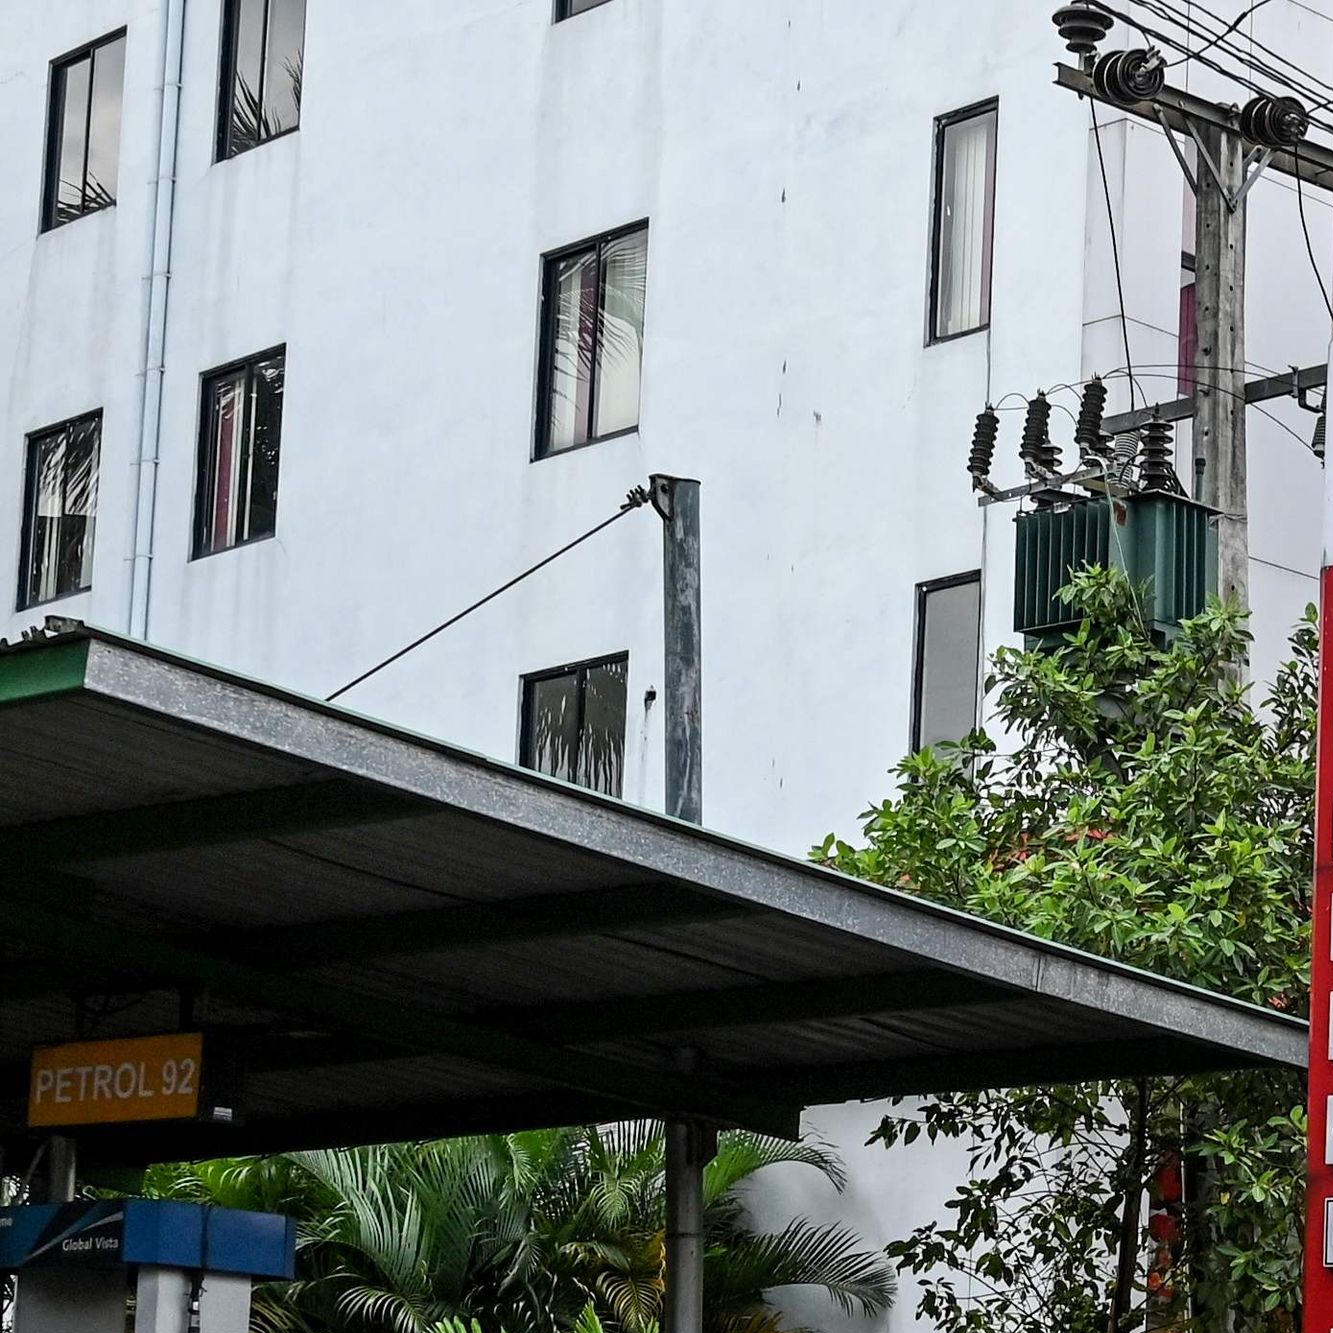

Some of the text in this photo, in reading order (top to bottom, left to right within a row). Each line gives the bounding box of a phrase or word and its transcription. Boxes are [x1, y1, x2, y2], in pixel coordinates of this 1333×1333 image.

[35, 1057, 196, 1105] PETROL 92
[62, 1236, 119, 1252] Global Vista
